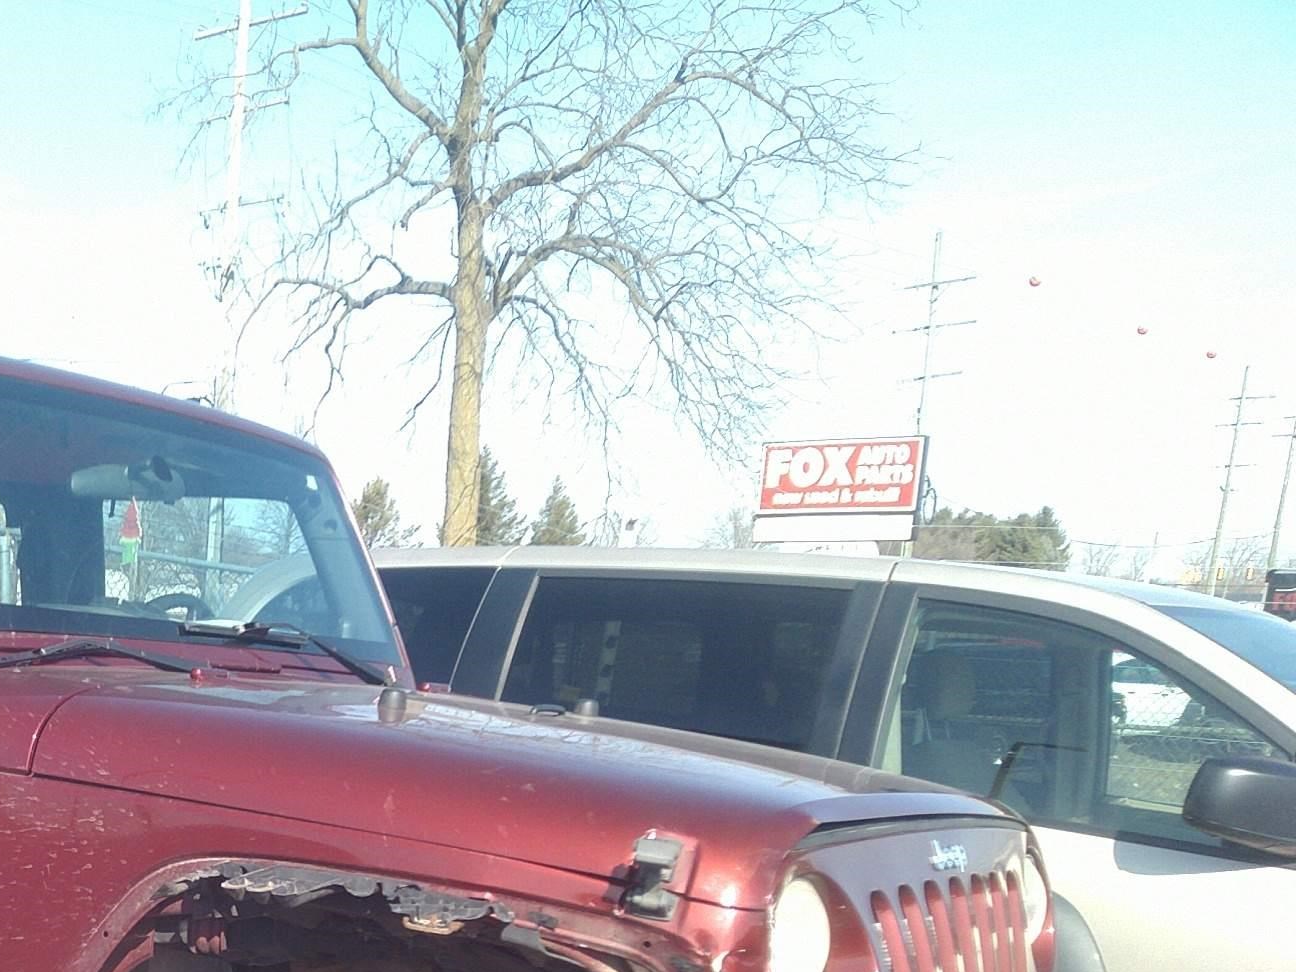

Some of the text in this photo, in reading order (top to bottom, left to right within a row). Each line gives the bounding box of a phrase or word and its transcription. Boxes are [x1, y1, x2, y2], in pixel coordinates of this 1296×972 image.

[765, 447, 857, 489] FOX
[857, 443, 911, 466] AUTO
[855, 464, 915, 485] PARTS
[928, 839, 968, 872] Jeep
